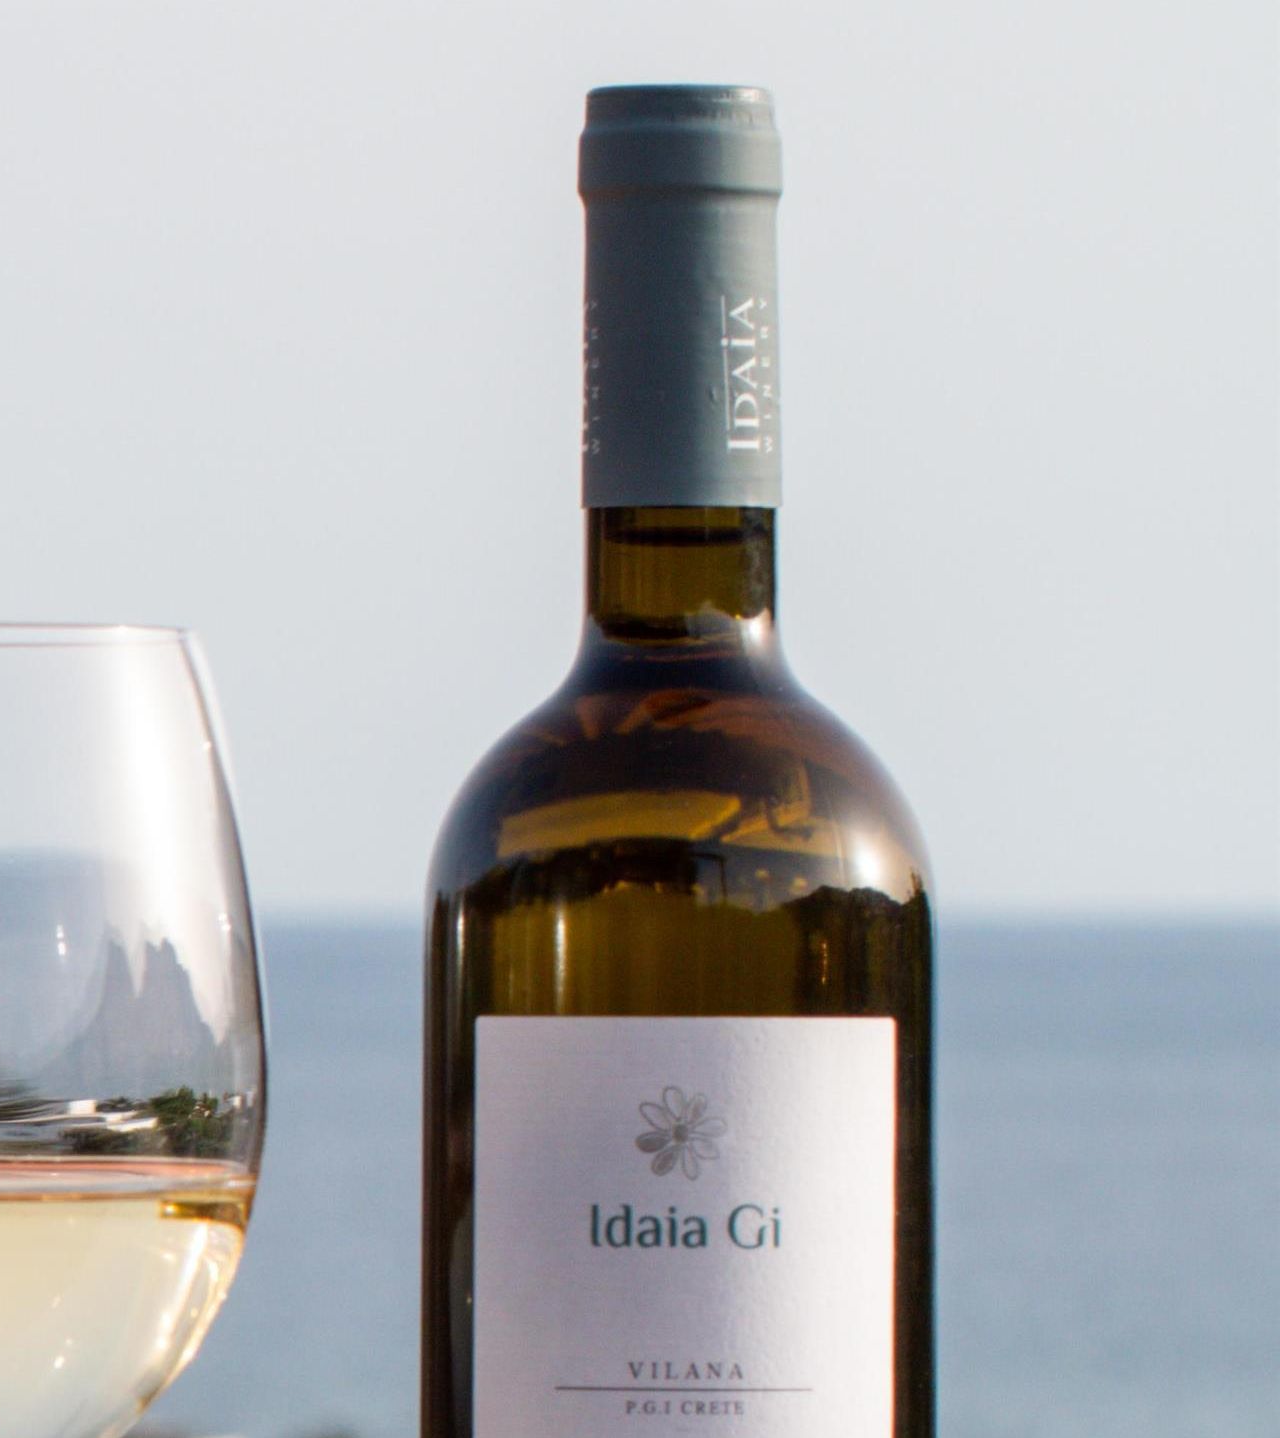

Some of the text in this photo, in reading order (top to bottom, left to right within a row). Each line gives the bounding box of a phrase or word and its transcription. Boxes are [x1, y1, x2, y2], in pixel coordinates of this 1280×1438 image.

[591, 1204, 781, 1250] Idaia Gi
[627, 1361, 744, 1380] VILANA
[680, 1400, 745, 1415] CRETE
